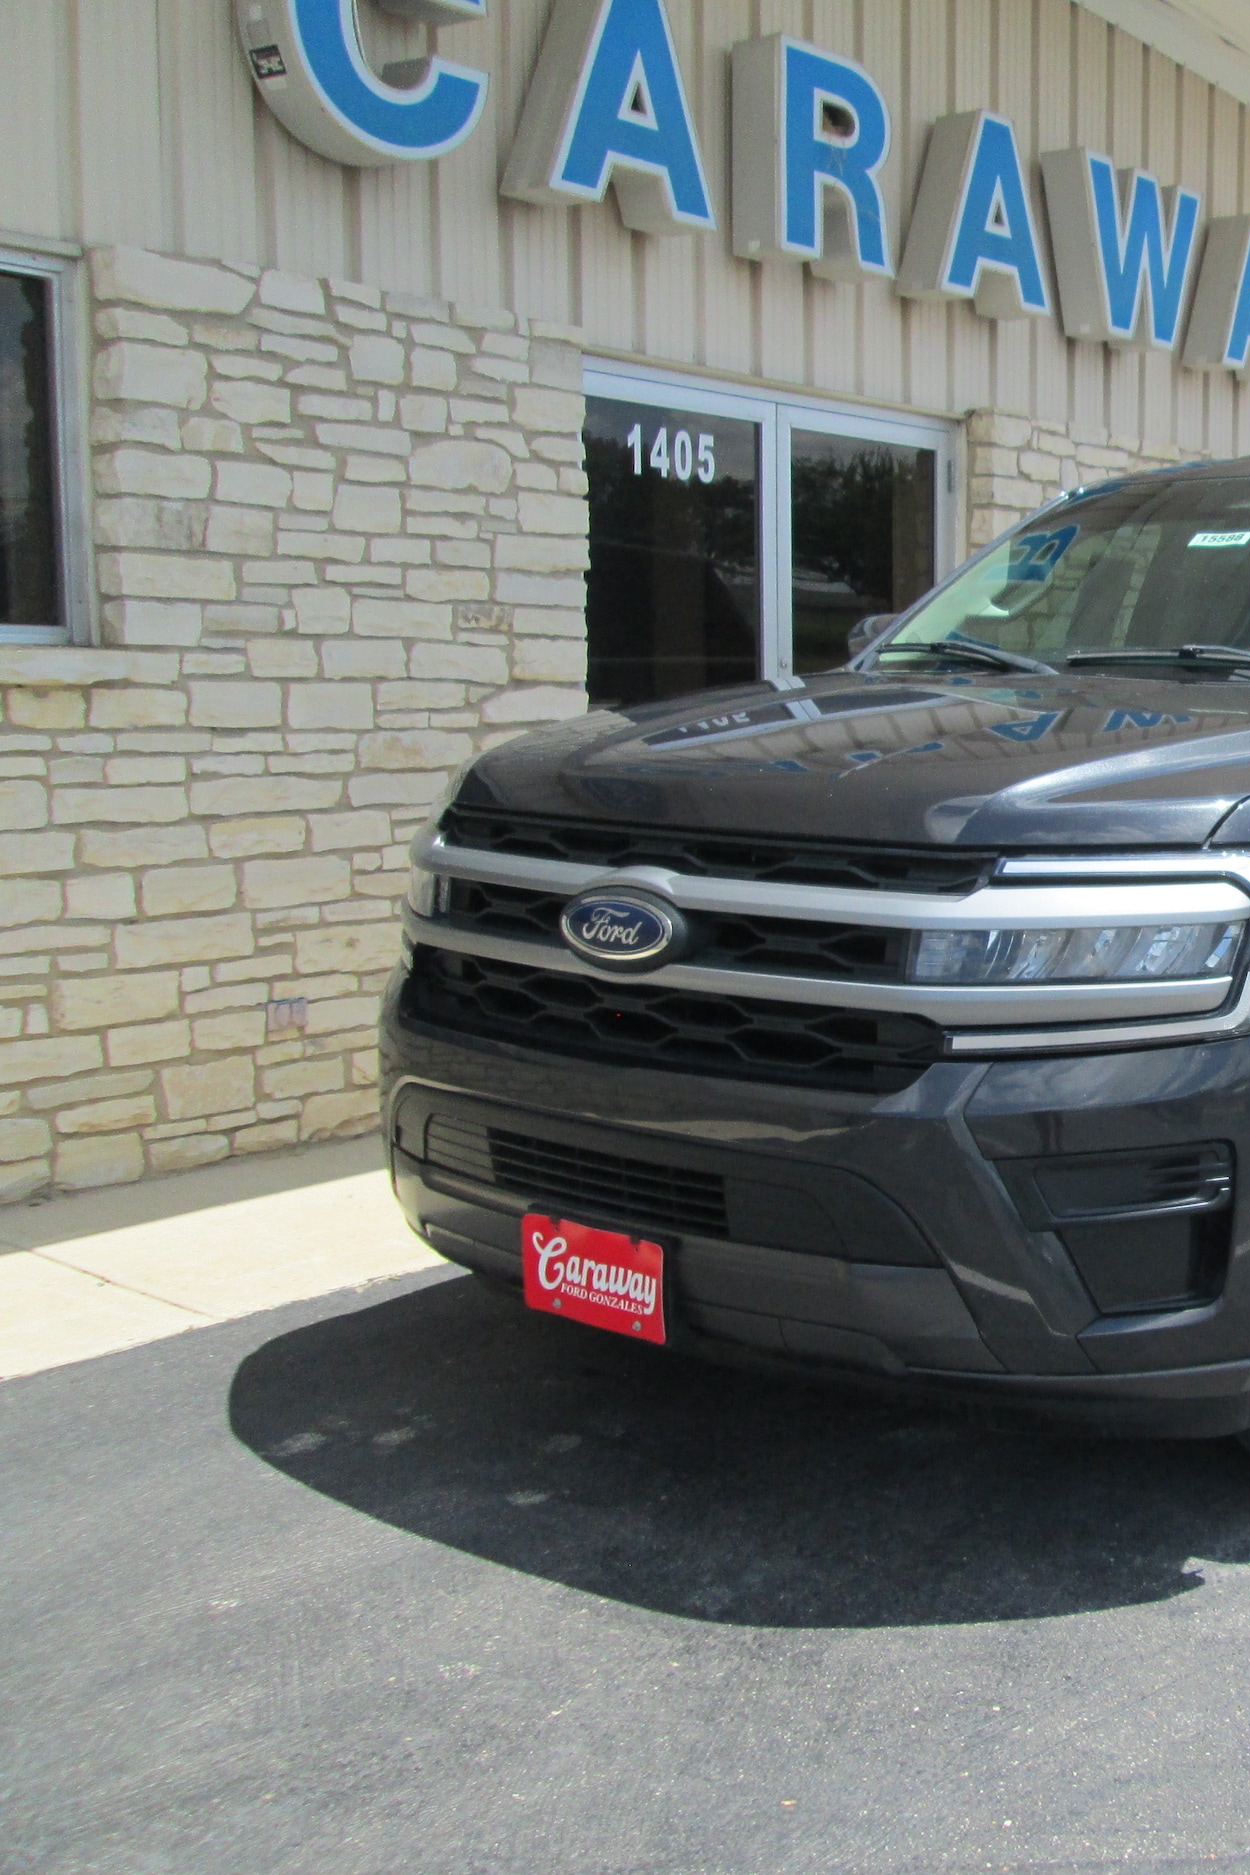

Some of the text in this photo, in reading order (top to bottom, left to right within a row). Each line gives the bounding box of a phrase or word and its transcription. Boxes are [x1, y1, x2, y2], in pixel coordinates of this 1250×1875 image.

[626, 423, 716, 484] 1405
[582, 906, 643, 945] Ford
[532, 1231, 657, 1316] Caraway
[560, 1283, 644, 1316] FORD GONZALES
